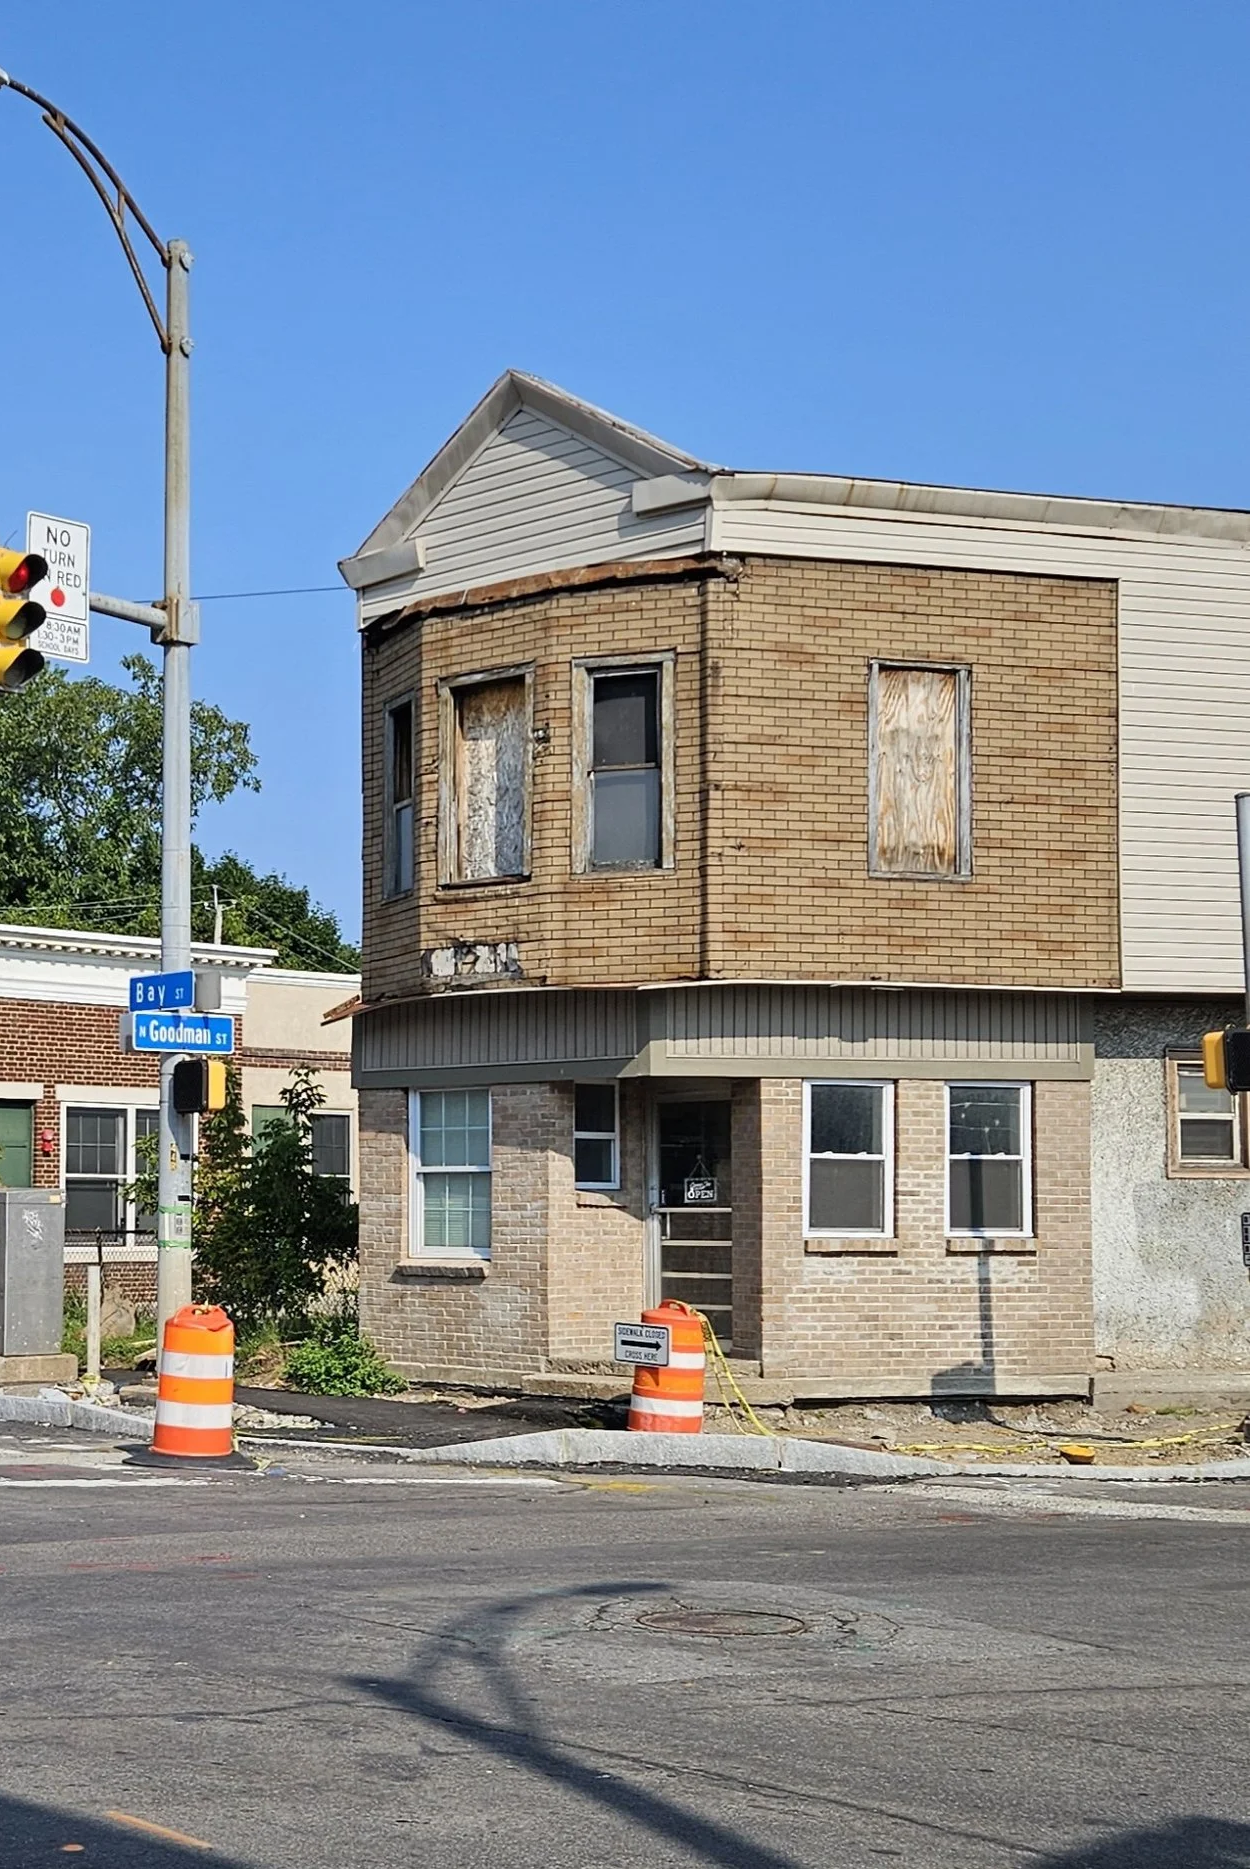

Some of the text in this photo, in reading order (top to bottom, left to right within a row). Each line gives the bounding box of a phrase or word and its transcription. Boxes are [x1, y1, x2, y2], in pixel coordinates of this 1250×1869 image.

[46, 526, 71, 547] NO
[42, 547, 75, 568] TURN
[57, 570, 82, 588] RED
[136, 982, 184, 1006] Bay ST
[138, 1019, 228, 1045] N Goodman ST
[687, 1190, 714, 1199] OPEN
[617, 1326, 666, 1340] SIDEWALK CLOSED
[625, 1349, 659, 1361] CROSS HERE
